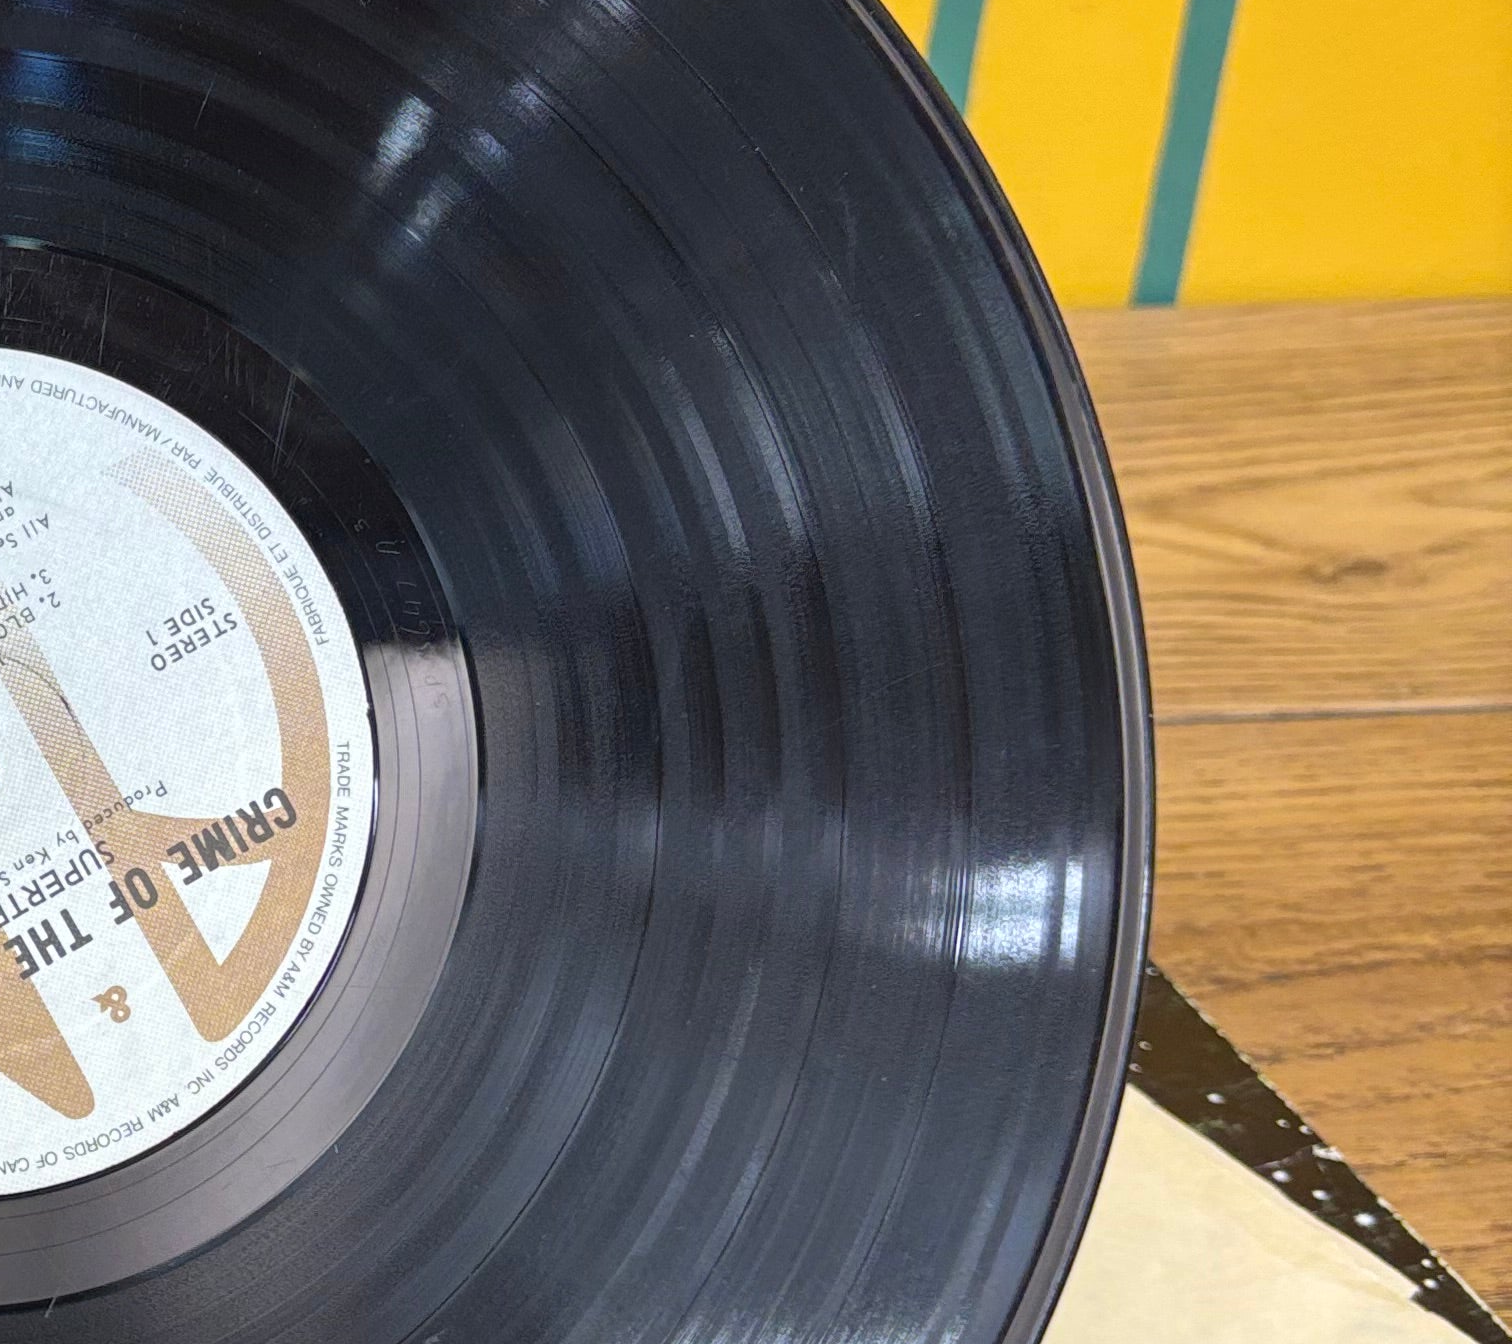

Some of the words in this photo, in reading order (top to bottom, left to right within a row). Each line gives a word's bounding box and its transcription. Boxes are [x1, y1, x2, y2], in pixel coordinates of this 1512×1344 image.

[20, 512, 49, 539] All
[266, 541, 289, 564] ET
[29, 567, 52, 585] 3.
[37, 590, 61, 609] 2.
[162, 596, 215, 637] SIDE
[144, 629, 159, 646] 1
[149, 611, 238, 672] STEREO
[335, 740, 351, 797] TRADE
[79, 776, 169, 838] Produced
[55, 828, 80, 847] by
[165, 786, 297, 886] CRIME
[327, 805, 350, 867] MARKS
[12, 846, 52, 871] Ken
[107, 866, 159, 925] OF
[306, 872, 338, 935] OWNED
[1, 907, 94, 981] THE
[295, 936, 315, 962] BY
[272, 959, 301, 999] A&M
[213, 1000, 277, 1071] RECORDS
[146, 1092, 180, 1122] A&M
[61, 1115, 145, 1161] RECORDS
[34, 1150, 58, 1169] OF
